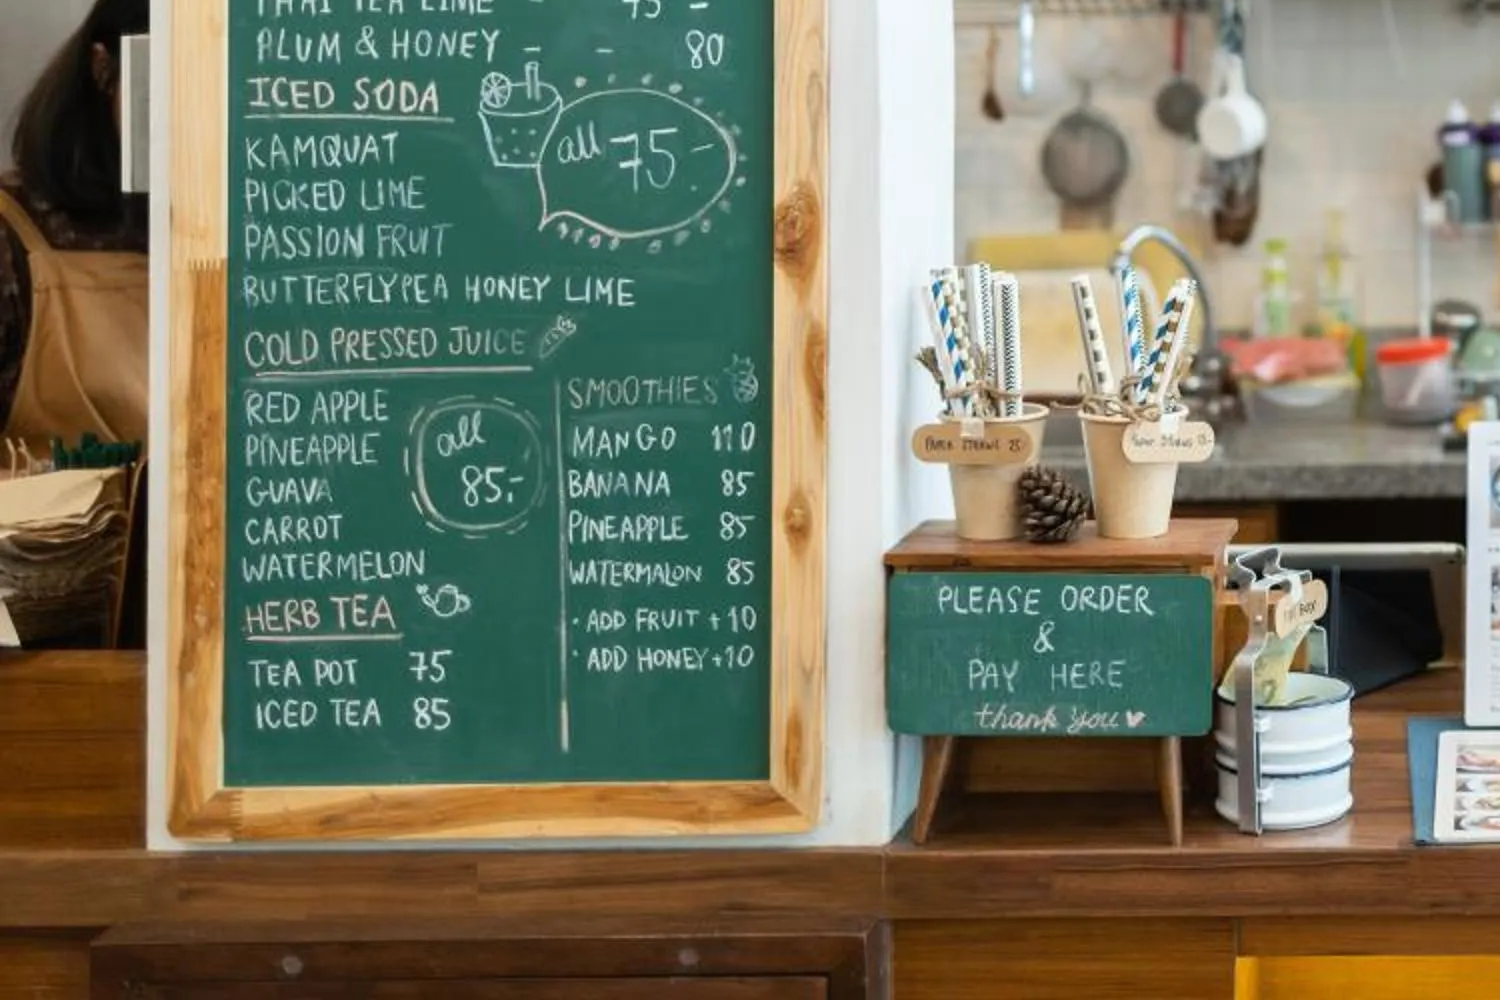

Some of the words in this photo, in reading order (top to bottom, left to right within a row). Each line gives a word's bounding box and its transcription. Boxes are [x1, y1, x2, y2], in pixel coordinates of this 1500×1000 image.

[257, 31, 340, 64] PLUM
[356, 31, 379, 59] &
[392, 30, 500, 60] HONEY
[686, 31, 723, 69] 80
[249, 77, 335, 110] ICED
[354, 77, 439, 114] SODA
[246, 131, 399, 170] KAMQUAT
[559, 122, 600, 165] all
[361, 176, 426, 210] LIME
[245, 225, 364, 261] PASSION
[377, 223, 452, 257] FRUIT
[466, 275, 551, 301] HONEY
[565, 275, 636, 306] LIME
[245, 328, 318, 367] COLD
[331, 326, 437, 360] PRESSED
[448, 326, 526, 356] JUICE
[245, 389, 300, 424] RED
[312, 389, 388, 423] APPLE
[568, 376, 718, 408] SMOOTHIES
[245, 433, 380, 467] PINEAPPLE
[437, 410, 485, 456] all
[573, 424, 677, 457] MANGO
[712, 423, 755, 452] 110
[245, 477, 334, 506] GUAVA
[568, 469, 670, 498] BANANA
[721, 470, 754, 497] 85
[245, 515, 342, 546] CARROT
[568, 510, 688, 544] PINEAPPLE
[719, 513, 755, 540] 85
[242, 550, 425, 581] WATERMELON
[726, 558, 755, 586] 85
[245, 598, 320, 633] HERB
[330, 594, 395, 630] TEA
[938, 585, 1041, 616] PLEASE
[1061, 585, 1154, 616] ORDER
[587, 609, 626, 630] ADD
[636, 607, 699, 629] FRUIT
[1034, 621, 1054, 653] &
[248, 659, 301, 687] TEA
[315, 659, 357, 687] POT
[410, 649, 452, 683] 75
[587, 648, 628, 672] ADD
[637, 647, 710, 670] HONEY
[968, 658, 1020, 692] PAY
[1051, 660, 1126, 689] HERE
[256, 700, 317, 729] ICED
[331, 698, 381, 728] TEA
[413, 698, 452, 730] 85
[975, 706, 1058, 731] thank
[1066, 705, 1119, 735] you
